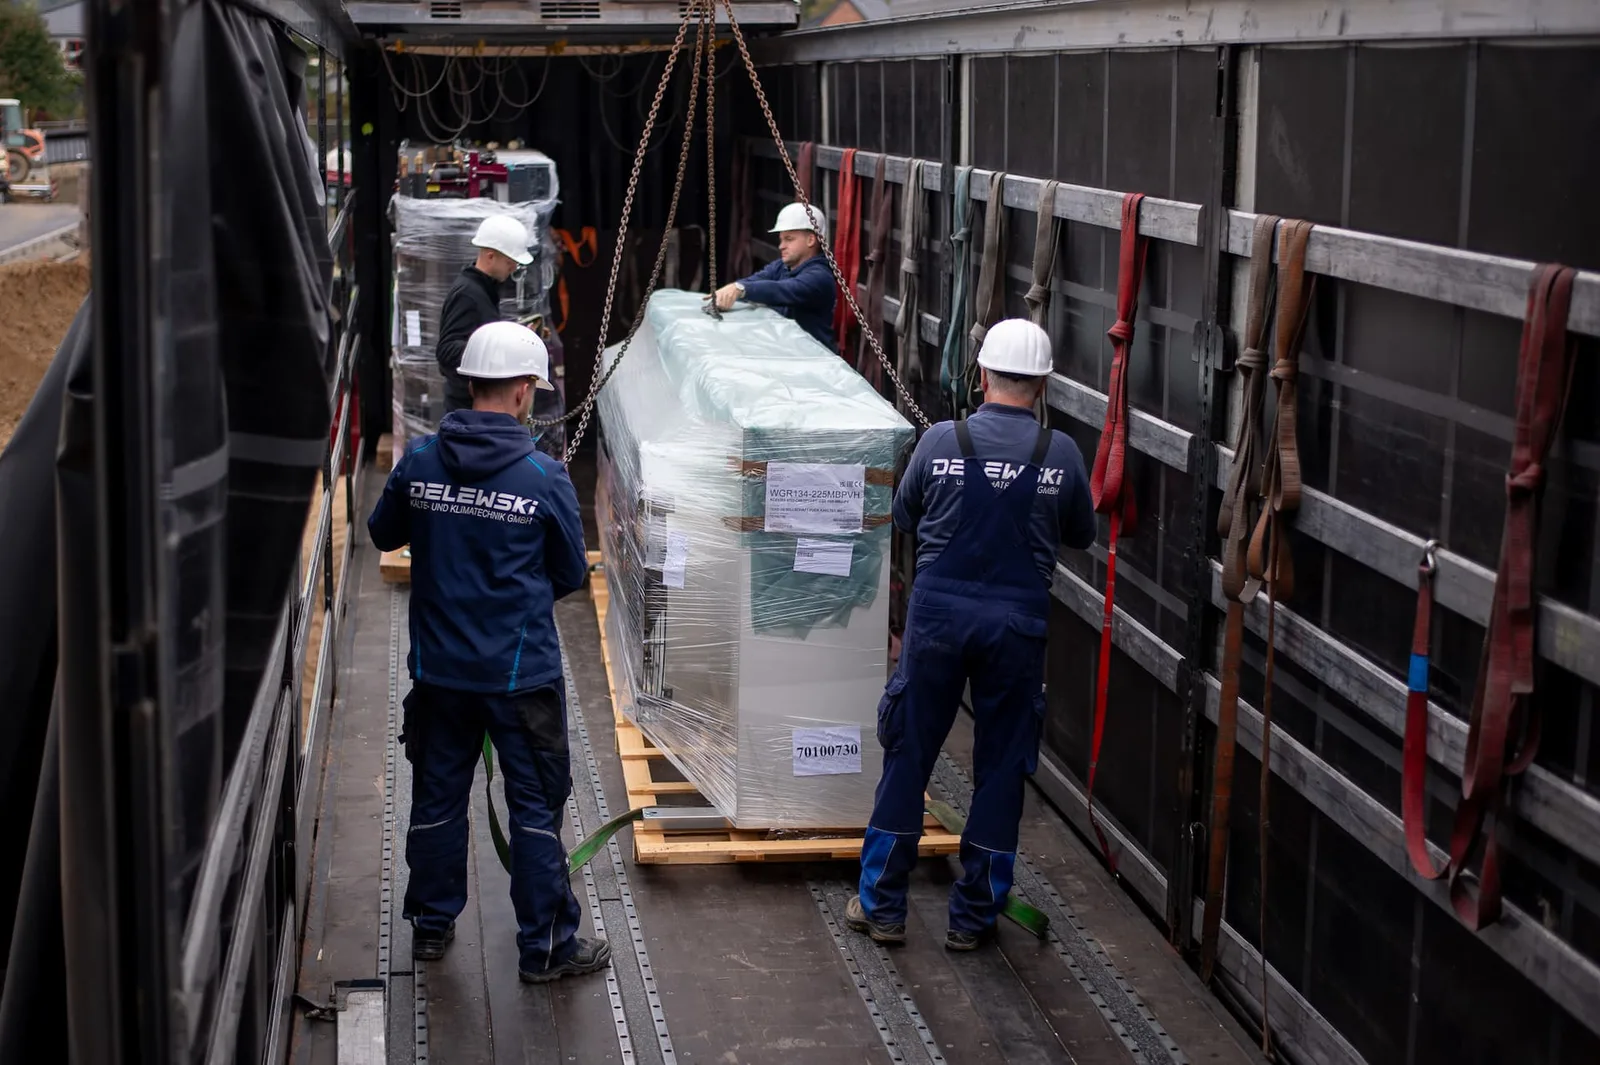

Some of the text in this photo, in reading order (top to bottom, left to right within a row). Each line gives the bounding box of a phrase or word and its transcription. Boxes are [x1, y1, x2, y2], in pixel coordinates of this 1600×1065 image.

[932, 458, 1064, 485] DEEWKi
[770, 489, 860, 499] WGR134-225MBPVH
[431, 502, 449, 512] UND
[449, 504, 506, 521] KLIMATECHNIK
[507, 513, 533, 525] GMBH
[797, 744, 858, 759] 70100730
